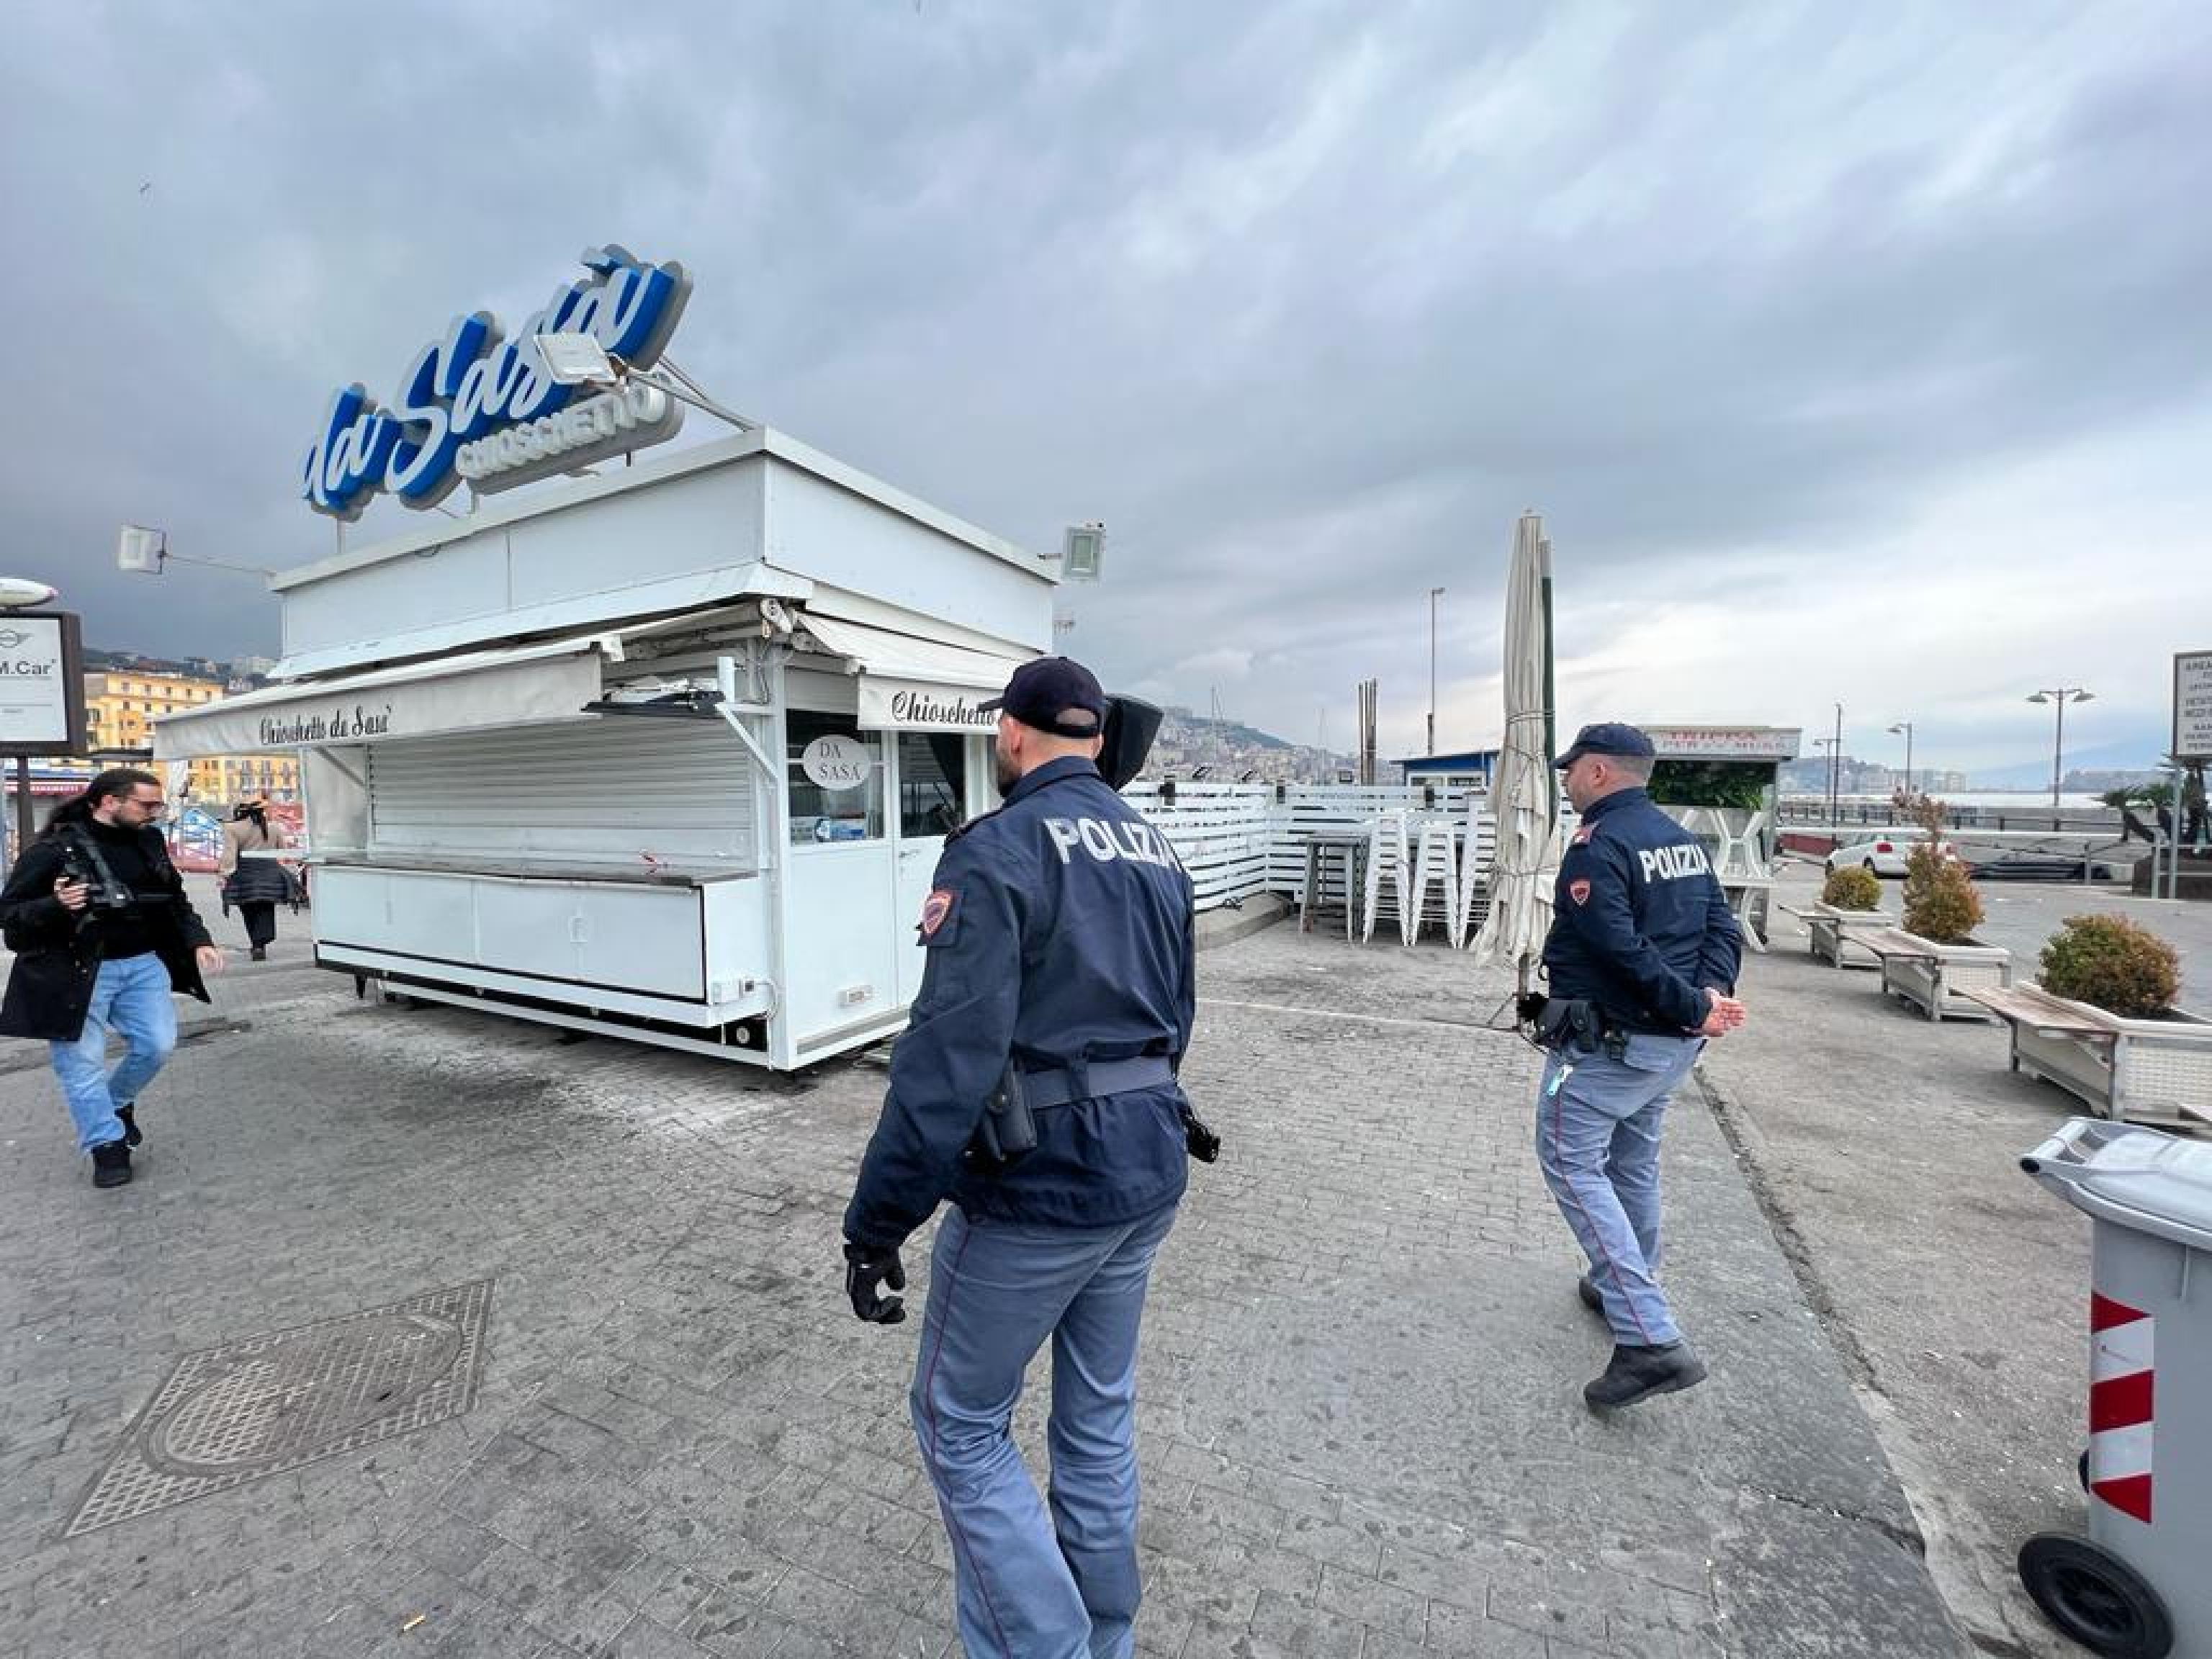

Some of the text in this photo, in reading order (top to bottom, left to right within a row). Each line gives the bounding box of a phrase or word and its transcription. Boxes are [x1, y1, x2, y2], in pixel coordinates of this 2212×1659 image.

[303, 385, 402, 513] da
[260, 715, 326, 745] Chioschetto
[330, 710, 348, 737] da
[820, 742, 841, 758] DA
[1043, 818, 1183, 873] POLIZIA
[1637, 844, 1712, 884] POLIZIA
